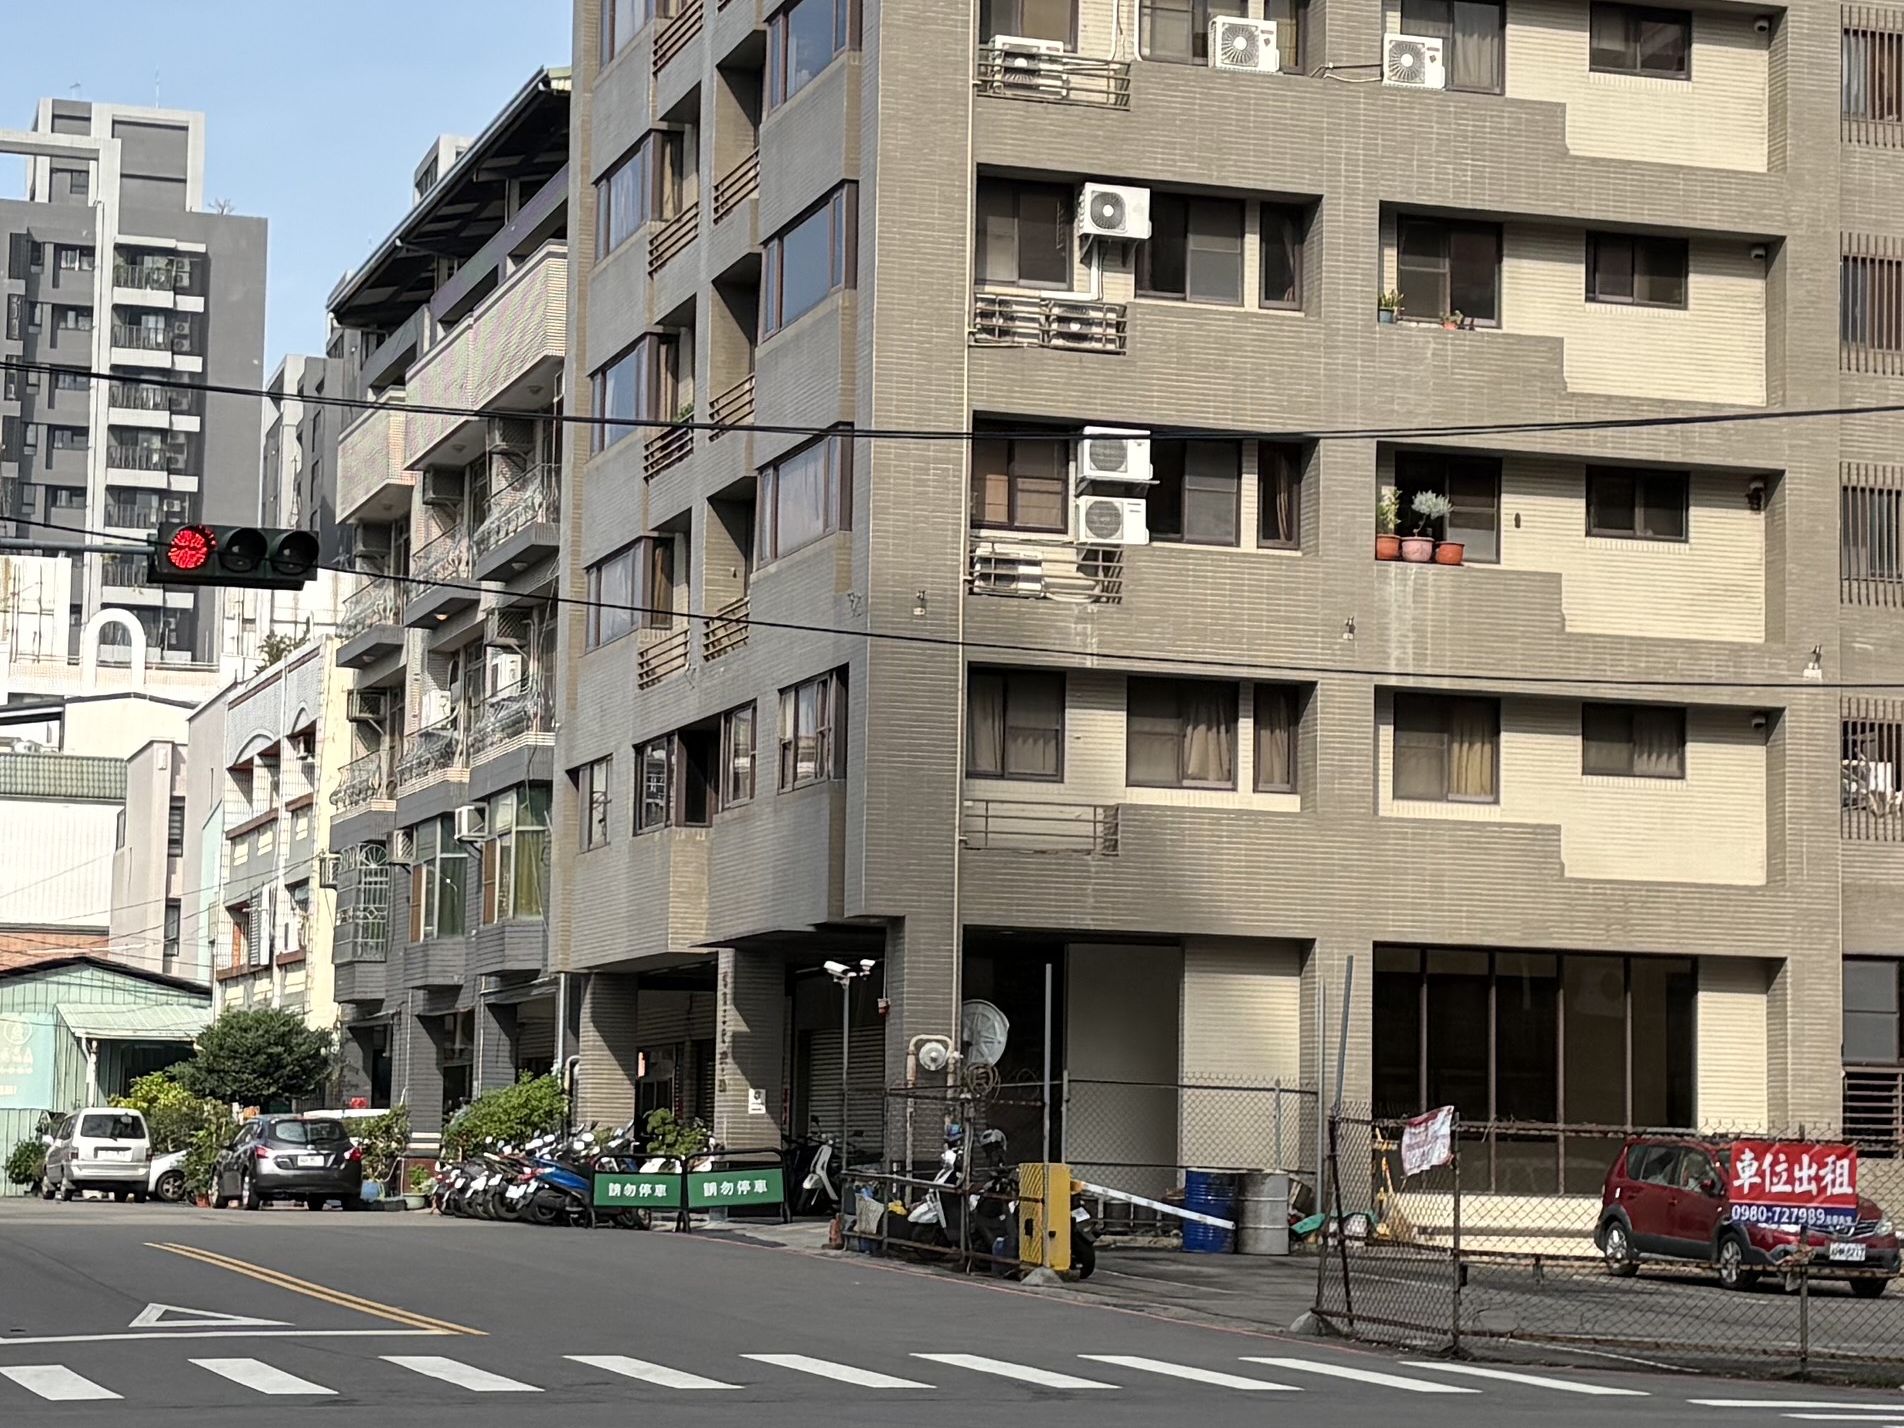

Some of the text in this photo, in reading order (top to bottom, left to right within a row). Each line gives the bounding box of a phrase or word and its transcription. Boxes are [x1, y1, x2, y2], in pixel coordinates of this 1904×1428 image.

[1732, 1148, 1854, 1196] 車位出租
[608, 1182, 667, 1197] 請勿停車
[703, 1180, 767, 1197] 請勿停車
[1731, 1204, 1826, 1225] 0980-727989
